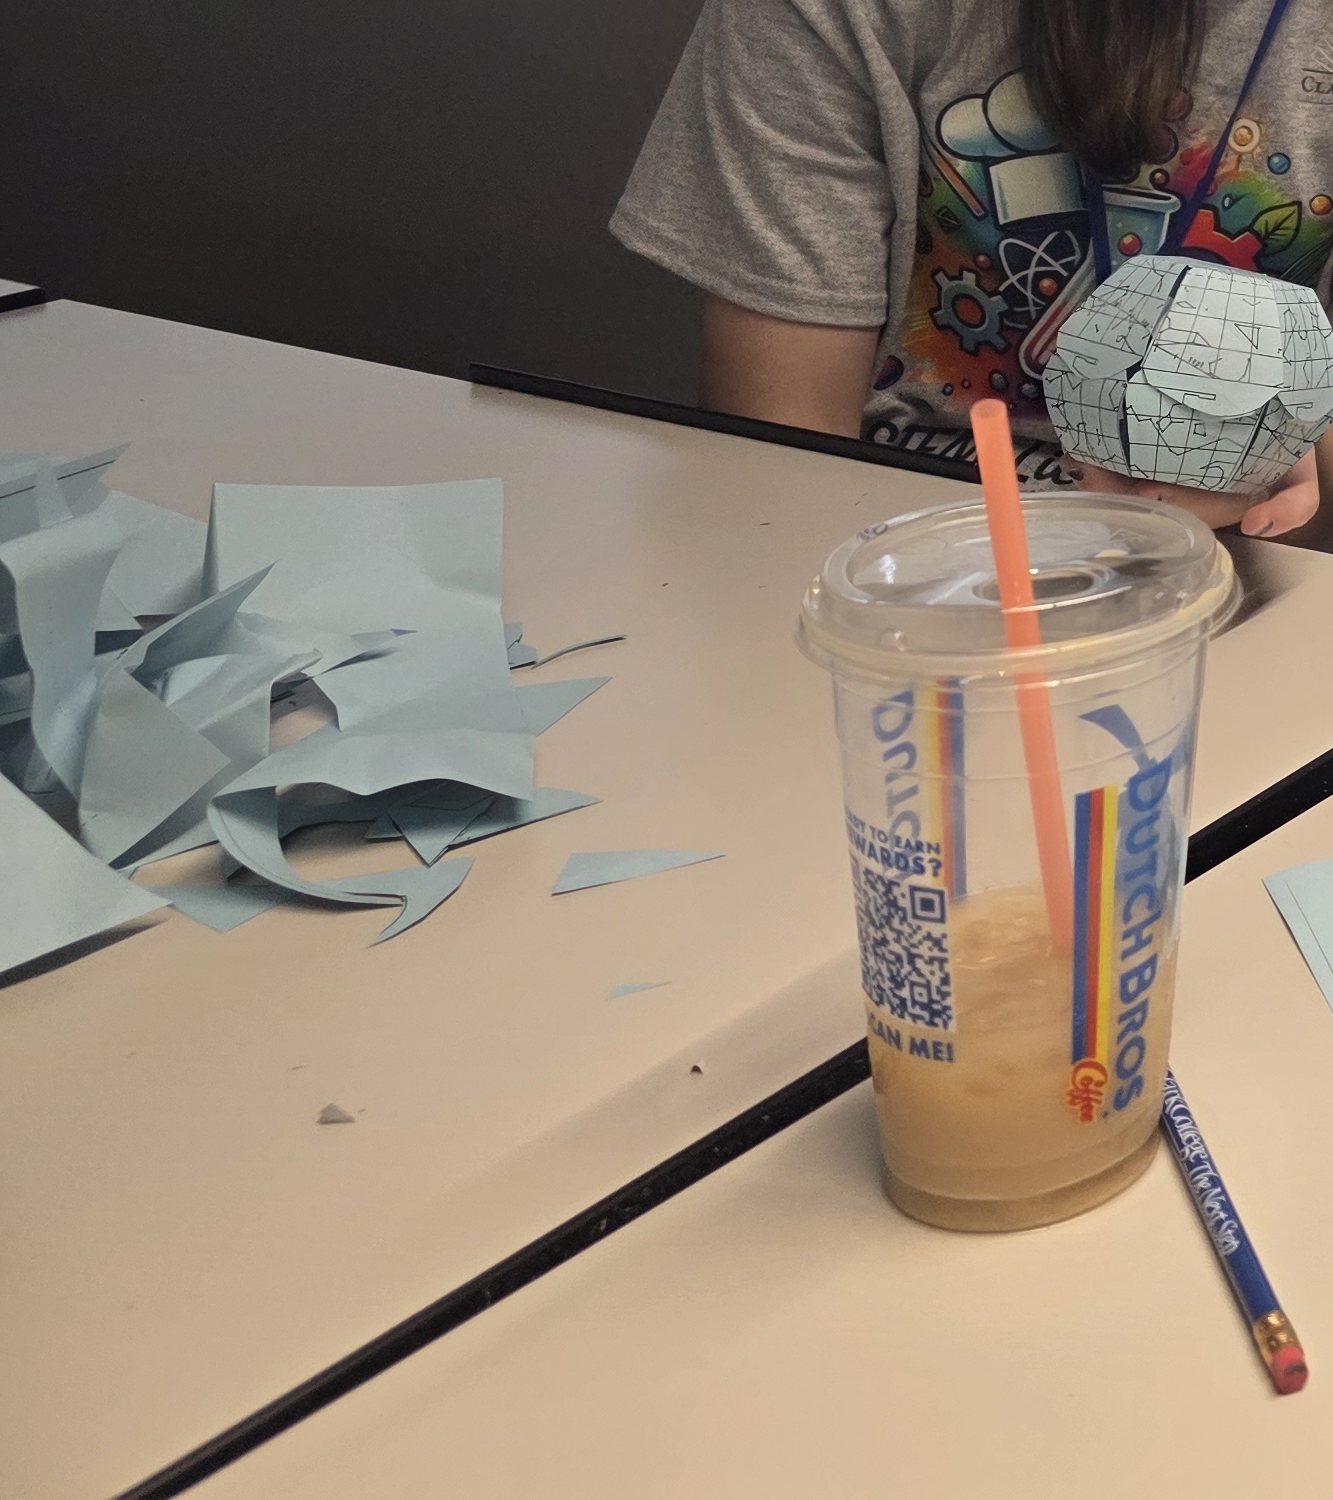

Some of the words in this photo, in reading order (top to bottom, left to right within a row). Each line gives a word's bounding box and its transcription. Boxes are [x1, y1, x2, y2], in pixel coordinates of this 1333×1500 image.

[868, 824, 889, 844] TO
[894, 834, 942, 856] EARN
[1120, 754, 1174, 963] DUTCH
[908, 1034, 956, 1064] ME!
[1112, 952, 1160, 1114] BROS
[1166, 1100, 1213, 1161] College
[1189, 1160, 1219, 1192] The
[1204, 1187, 1227, 1224] Next
[1215, 1220, 1239, 1254] Step
